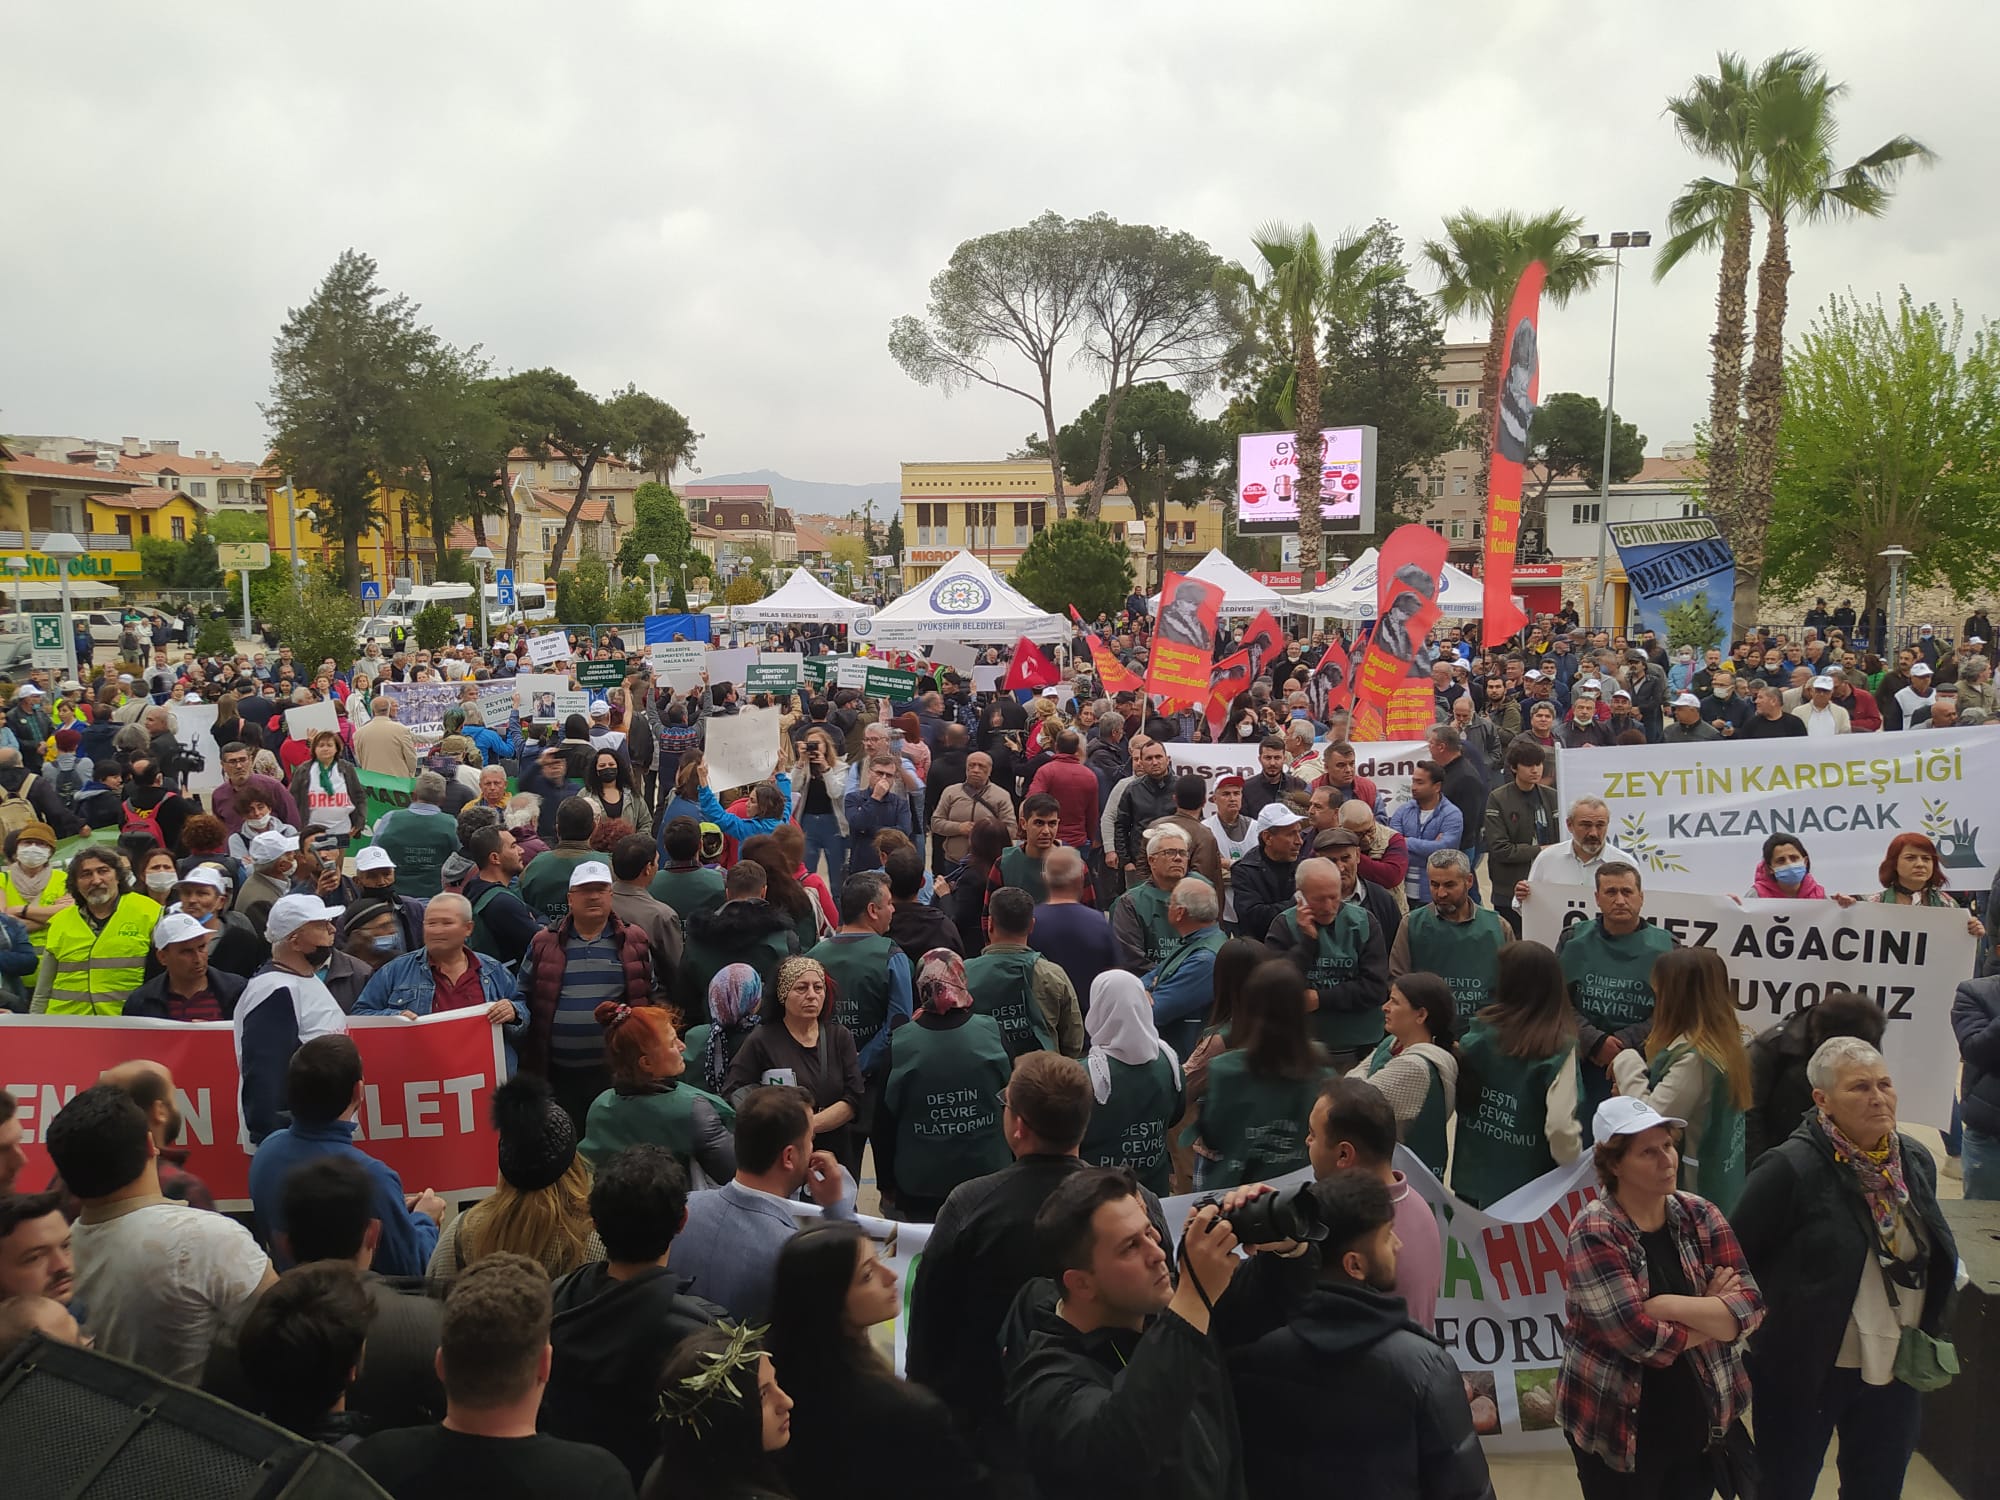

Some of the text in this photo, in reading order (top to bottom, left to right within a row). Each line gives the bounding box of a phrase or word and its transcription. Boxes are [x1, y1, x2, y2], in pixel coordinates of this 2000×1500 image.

[1656, 520, 1718, 541] HAYATTIR
[500, 589, 509, 603] P
[917, 621, 960, 632] ÜYÜKŞEHİR
[962, 621, 1006, 631] BELEDİYESİ
[487, 704, 514, 716] DOKUN
[1603, 747, 1963, 798] ZEYTİN KARDEŞLİĞİ
[1668, 802, 1902, 839] KAZANACAK
[1730, 915, 1928, 966] AĞACINI
[831, 1014, 860, 1025] EVRE
[926, 1088, 978, 1105] DEŞTİN
[930, 1105, 977, 1122] ÇEVRE
[1479, 1103, 1516, 1128] ÇEVRE
[913, 1113, 994, 1135] PLATFORMU
[1122, 1135, 1163, 1155] ÇEVRE
